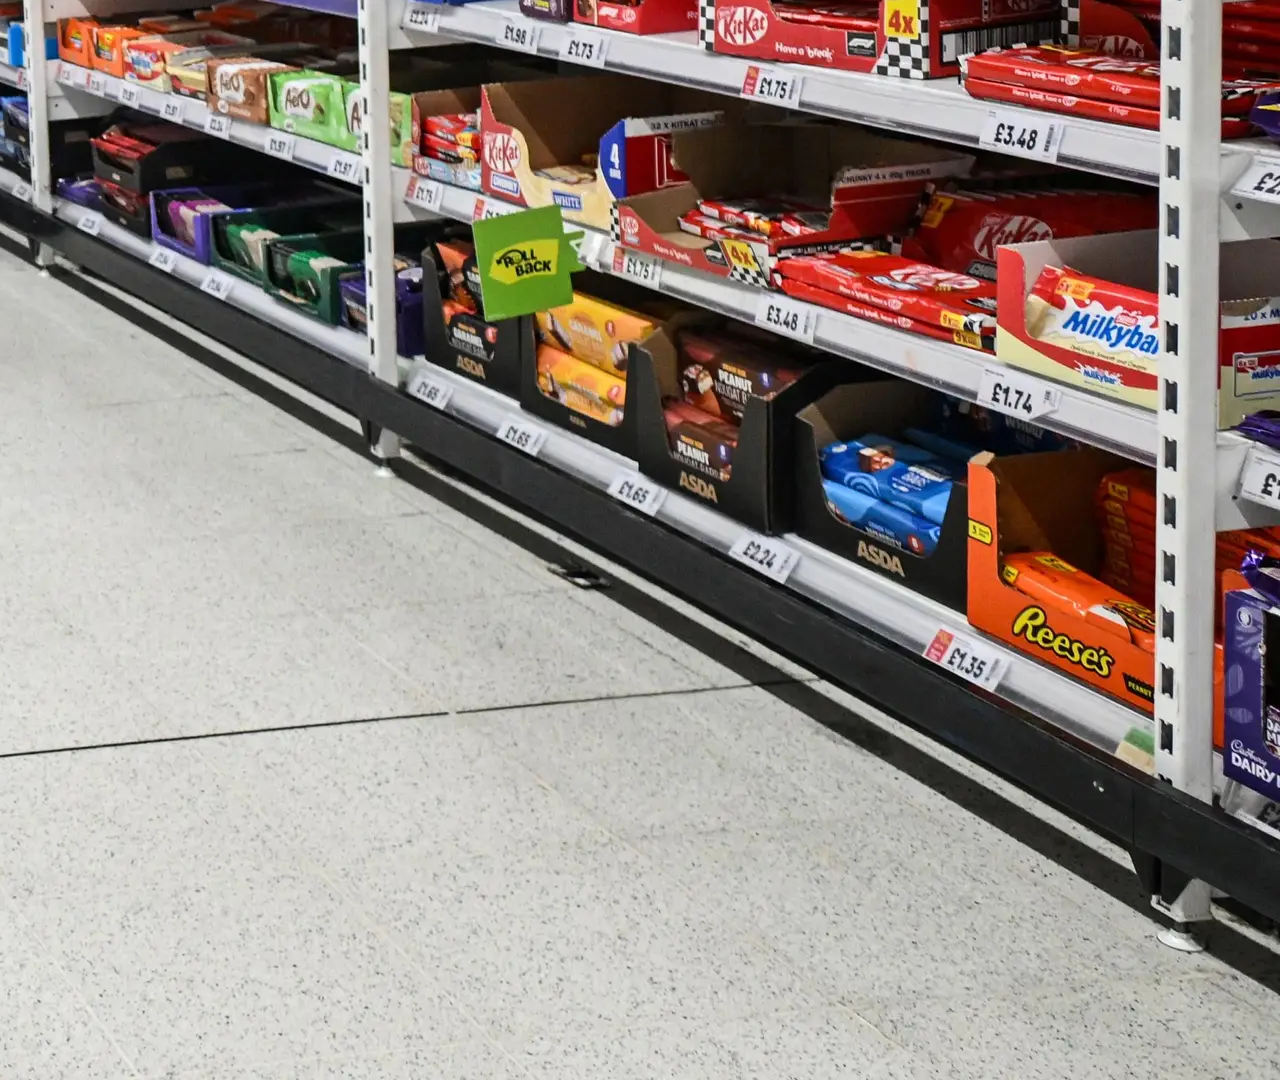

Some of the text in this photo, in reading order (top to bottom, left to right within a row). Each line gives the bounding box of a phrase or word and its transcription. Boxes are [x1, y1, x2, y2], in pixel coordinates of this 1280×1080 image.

[718, 9, 767, 44] KitKat
[887, 11, 915, 34] 4x
[567, 40, 594, 60] £1.73
[758, 77, 788, 98] £1.75
[993, 122, 1038, 150] £3.48
[488, 134, 519, 171] KitKat
[553, 194, 583, 209] WHITE
[503, 248, 538, 269] ROLL
[626, 255, 650, 280] £1.75
[767, 304, 799, 331] £3.48
[456, 354, 486, 381] ASDA
[990, 383, 1033, 414] £1.74
[677, 440, 709, 466] PEANUT
[679, 470, 719, 503] ASDA
[742, 539, 775, 568] £2.24
[857, 540, 905, 578] ASDA
[1012, 606, 1115, 677] Reese's
[946, 647, 987, 678] £1.35
[1231, 754, 1276, 782] DAIRY
